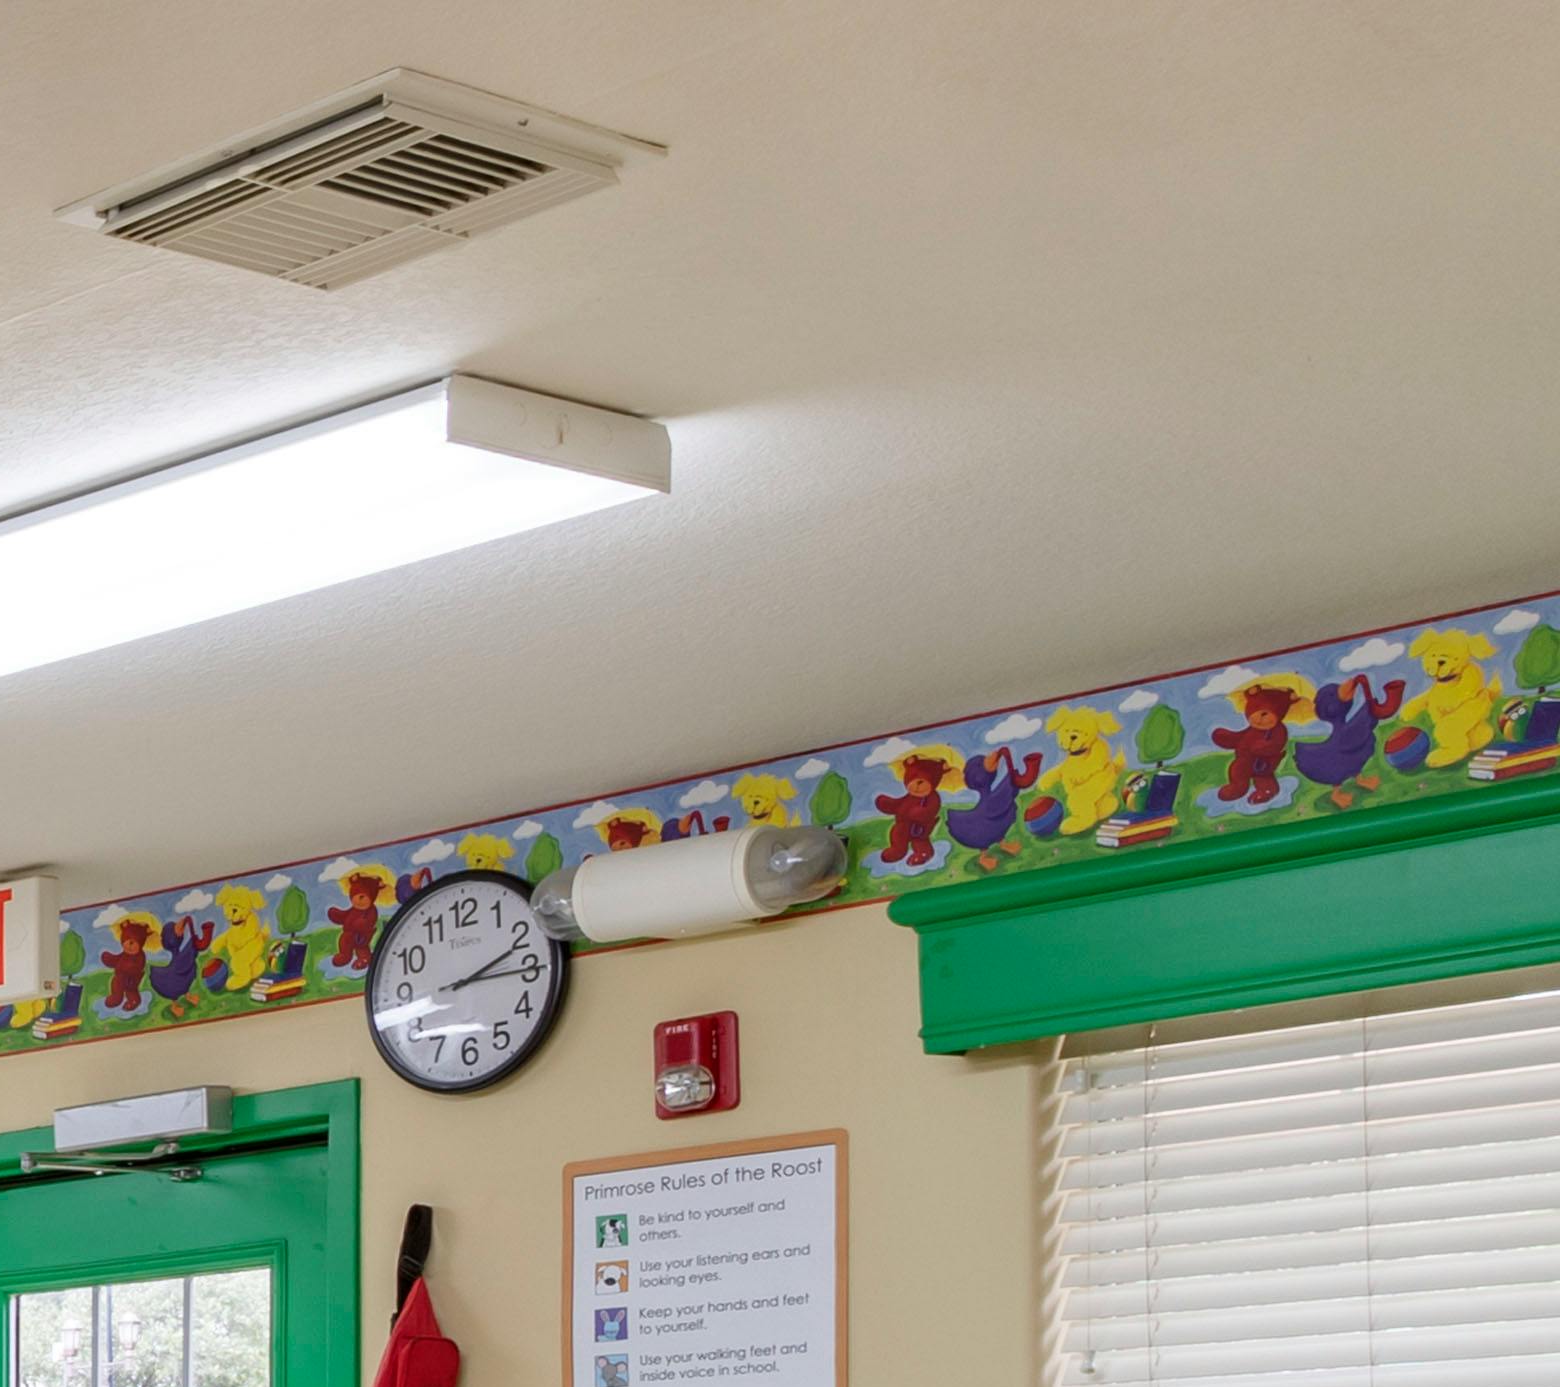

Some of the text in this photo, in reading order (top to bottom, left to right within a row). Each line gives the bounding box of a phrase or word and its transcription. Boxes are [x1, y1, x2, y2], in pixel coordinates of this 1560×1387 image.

[449, 898, 478, 929] 12
[490, 900, 503, 929] 1
[422, 913, 444, 945] 11
[511, 920, 530, 951] 2
[397, 945, 425, 976] 10
[521, 953, 539, 984] 3
[397, 981, 413, 1007] 9
[514, 991, 533, 1019] 4
[429, 1035, 447, 1063] 7
[492, 1021, 511, 1051] 5
[461, 1036, 479, 1066] 6
[584, 1158, 823, 1201] Primrose Rules of the Roost
[638, 1199, 786, 1227] Be kind to yourself and
[638, 1228, 682, 1243] others.
[639, 1244, 811, 1273] Use your listening ears and
[638, 1271, 723, 1289] looking eyes.
[639, 1292, 810, 1321] Keep your hands and feet
[639, 1318, 708, 1336] to yourself.
[639, 1341, 808, 1366] Use your walking feet and
[639, 1360, 781, 1382] inside voice in school.
